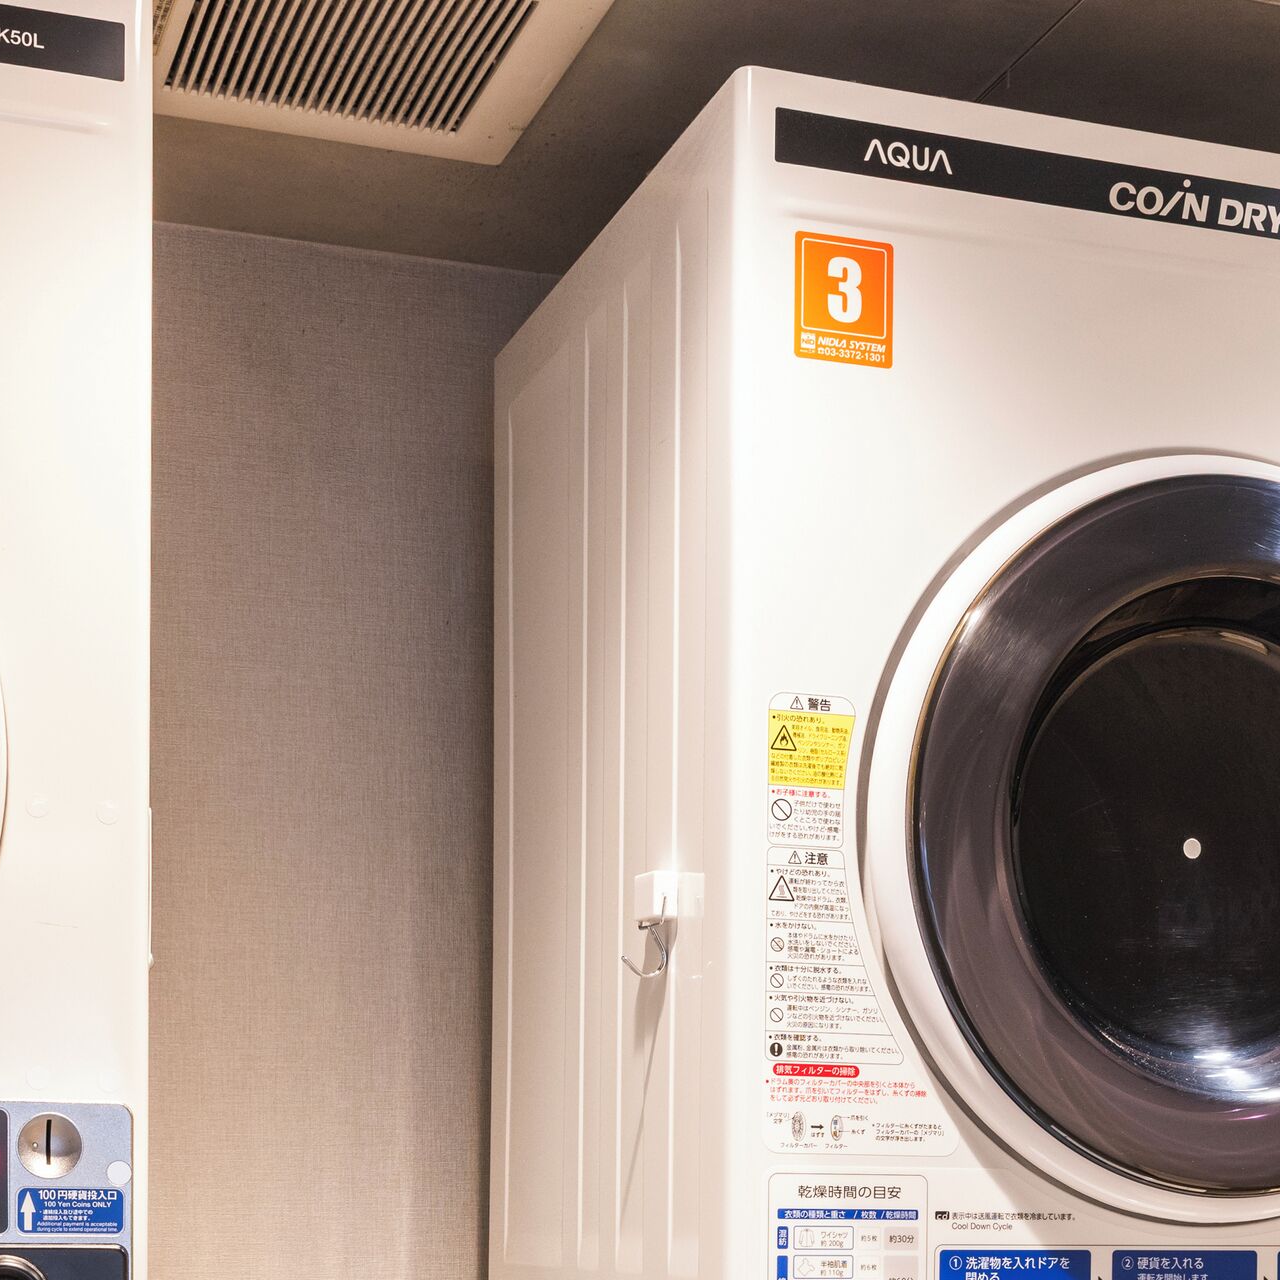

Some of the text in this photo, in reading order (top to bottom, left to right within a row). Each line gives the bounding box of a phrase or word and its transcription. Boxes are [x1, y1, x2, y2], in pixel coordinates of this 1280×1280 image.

[864, 138, 953, 175] AQUA
[827, 256, 862, 323] 3
[817, 336, 886, 353] NIDLA SYSTEM
[804, 852, 829, 866] 注意
